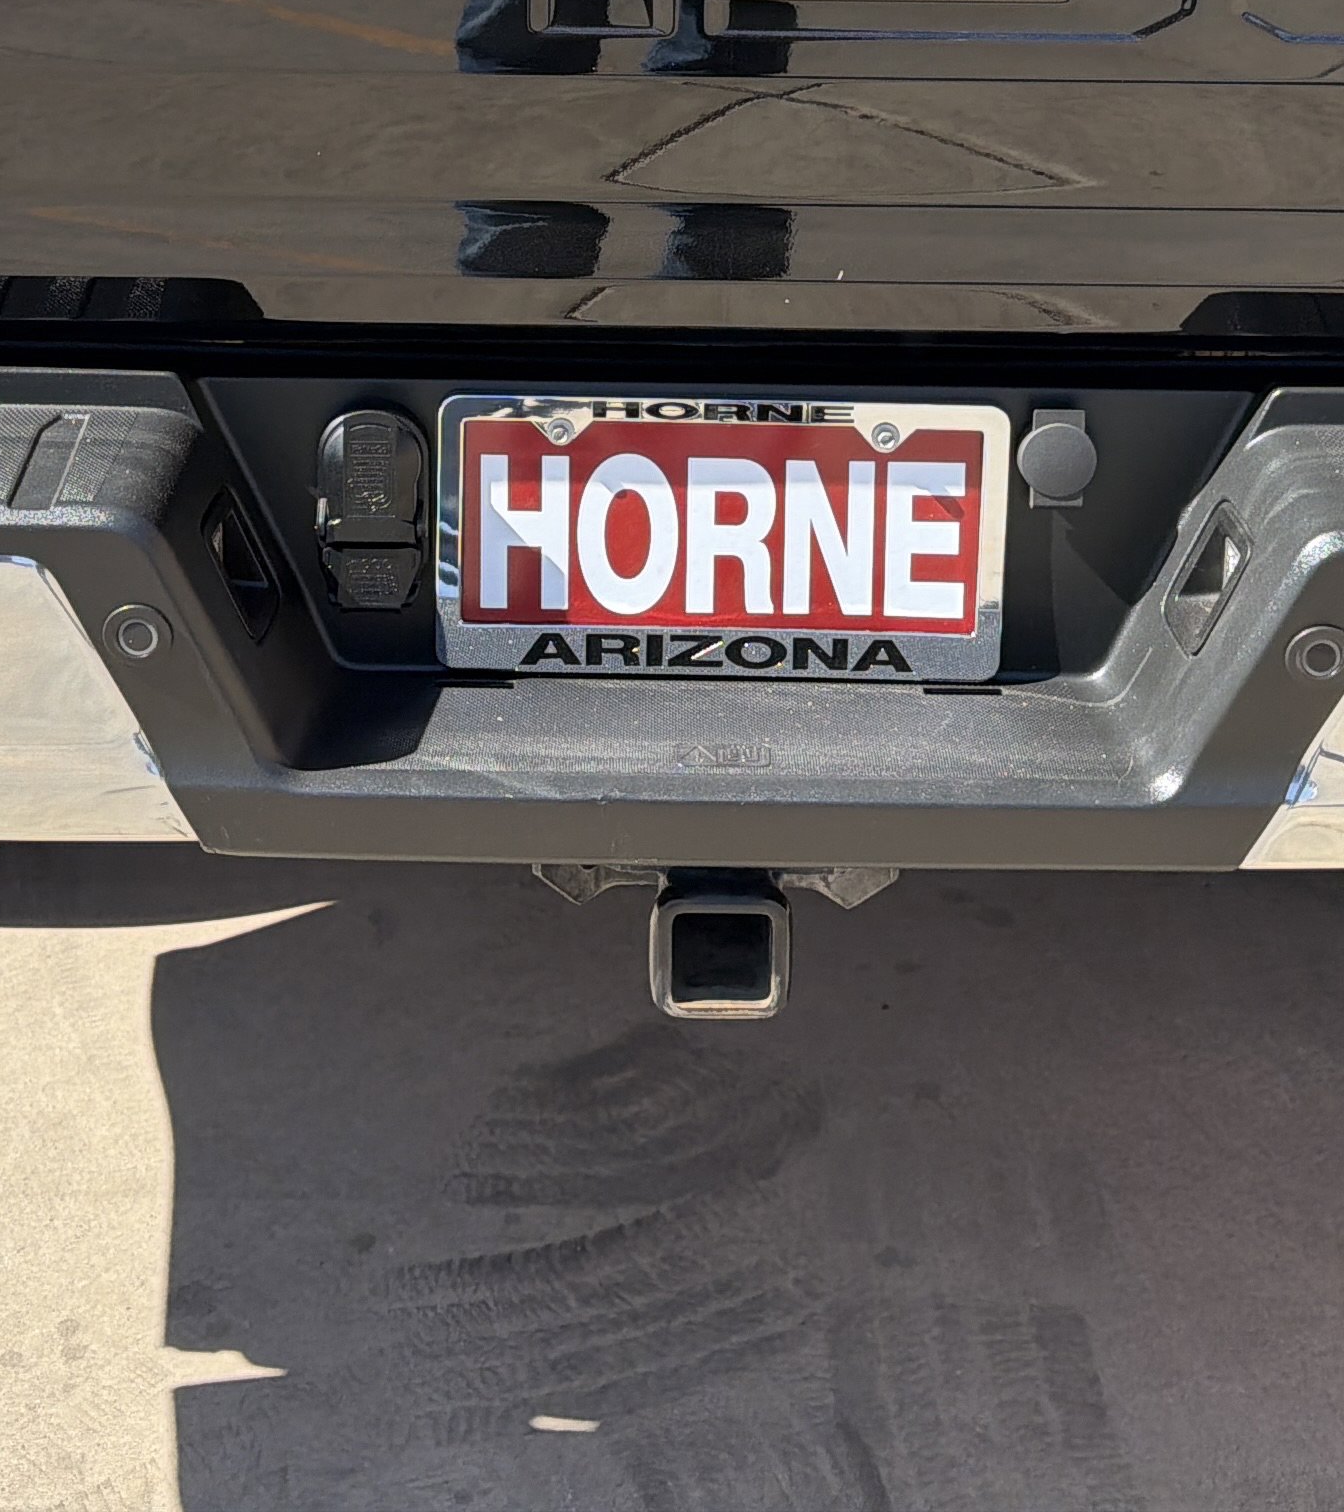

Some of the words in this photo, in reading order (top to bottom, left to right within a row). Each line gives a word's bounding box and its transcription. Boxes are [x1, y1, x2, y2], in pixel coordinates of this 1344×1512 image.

[592, 400, 855, 424] HORNE
[479, 452, 967, 620] HORNE
[518, 632, 914, 673] ARIZONA
